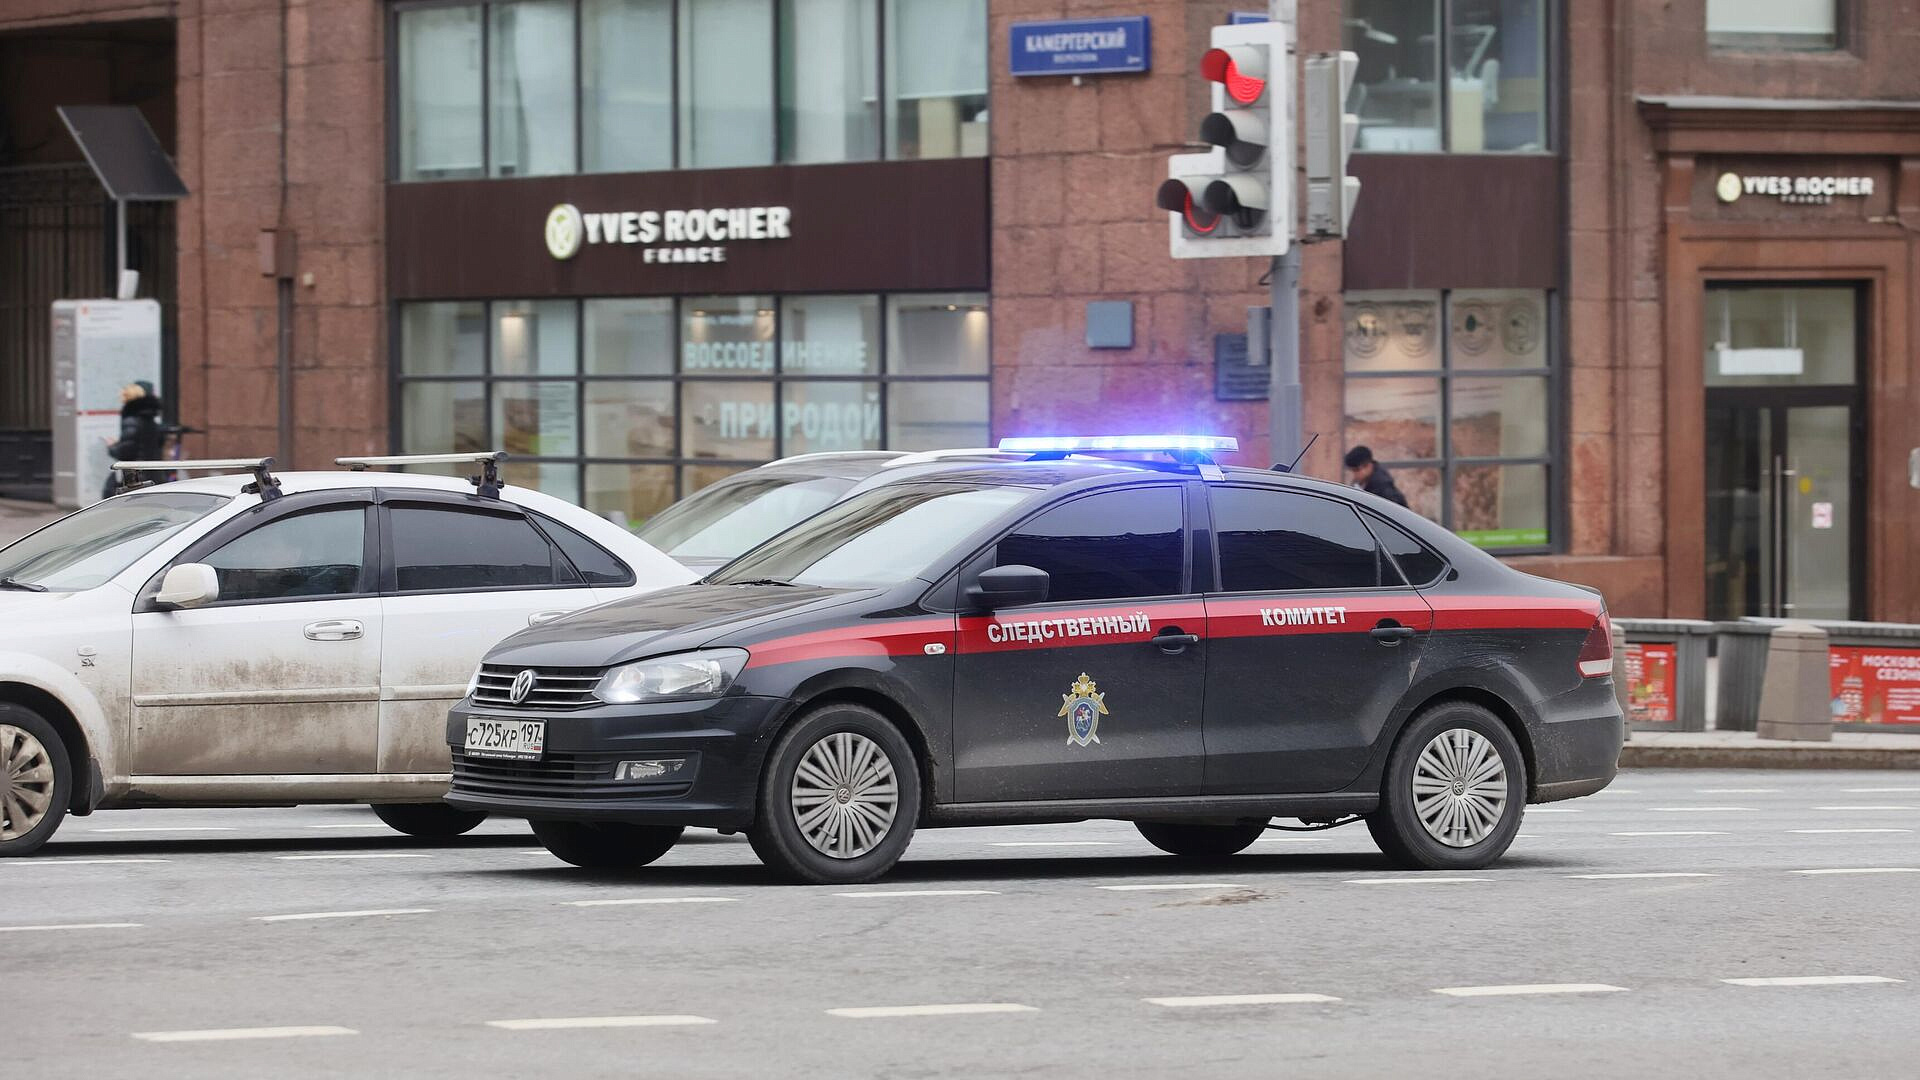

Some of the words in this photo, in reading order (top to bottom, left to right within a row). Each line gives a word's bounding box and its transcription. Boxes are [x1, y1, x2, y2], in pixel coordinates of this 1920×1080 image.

[1025, 27, 1126, 52] КАМЕРГЕРСКИЙ
[1743, 176, 1792, 195] YVES
[1794, 176, 1874, 195] ROCHER
[583, 211, 660, 244] YVES
[663, 206, 791, 242] ROCHER
[643, 247, 727, 263] FRANCE
[719, 392, 880, 445] ПРИРОДОЙ
[986, 610, 1151, 643] СЛЕДСТВЕННЫЙ
[1259, 606, 1347, 626] КОМИТЕТ
[1876, 668, 1920, 681] СЕЗОН
[469, 722, 518, 747] С725КР
[521, 723, 541, 742] 197
